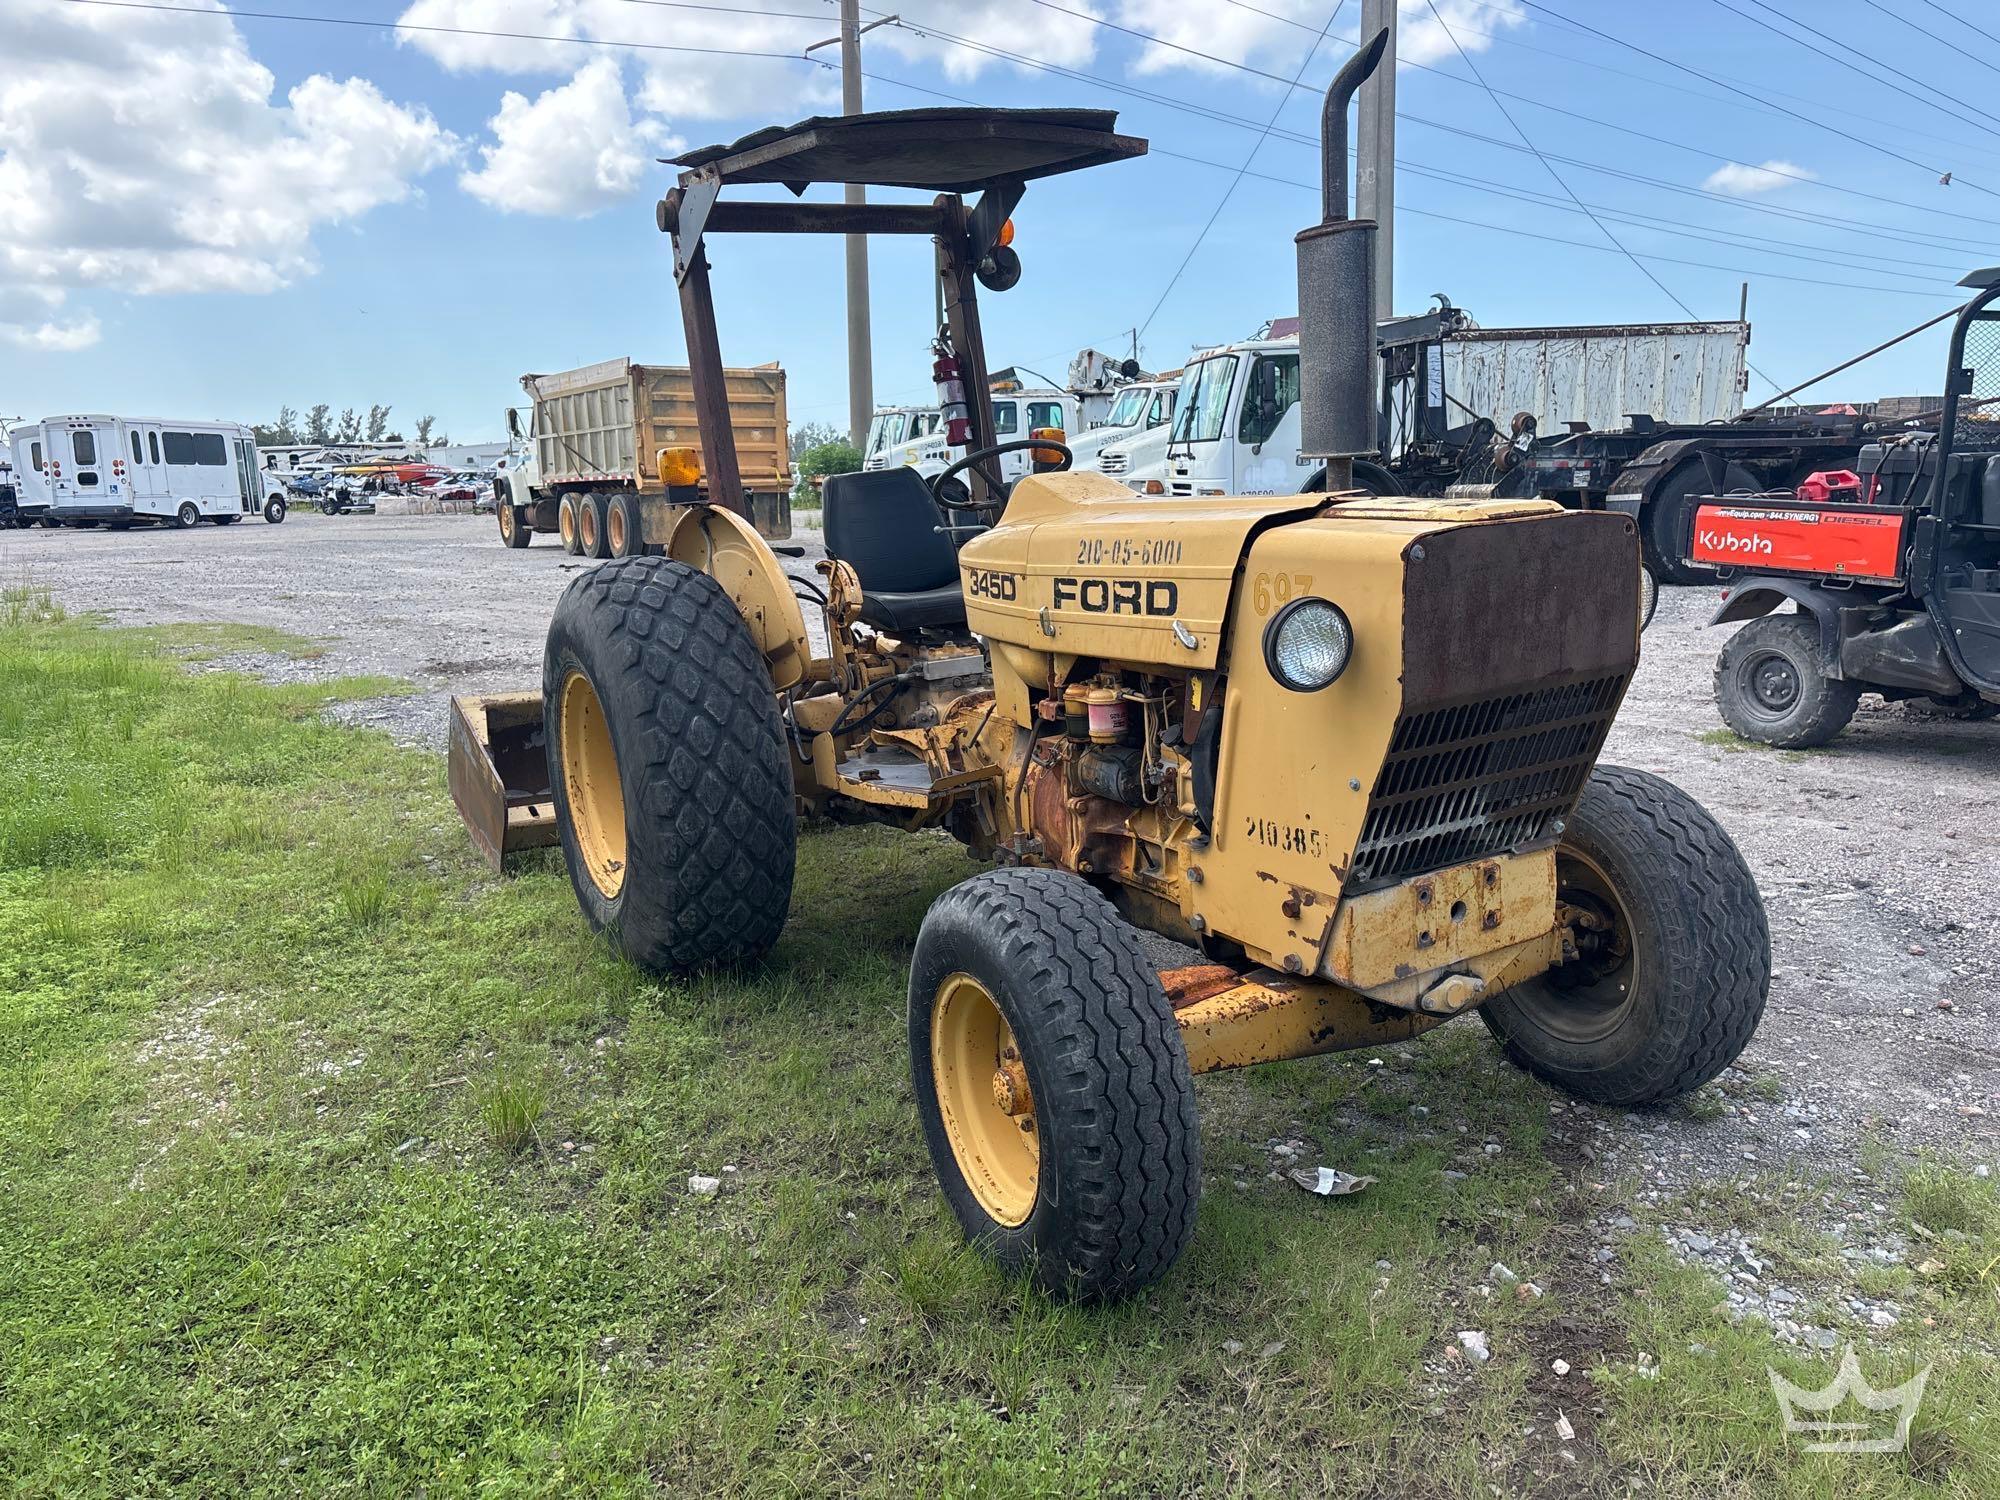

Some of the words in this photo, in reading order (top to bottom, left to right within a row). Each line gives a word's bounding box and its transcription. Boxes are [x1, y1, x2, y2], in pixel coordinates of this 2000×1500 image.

[905, 448, 918, 464] 5
[1824, 516, 1888, 527] DIESEL
[1077, 538, 1182, 566] 210-05-6001
[1700, 530, 1773, 554] Kubota
[970, 567, 1017, 602] 345D
[1053, 577, 1179, 616] FORD
[1253, 572, 1313, 617] 697
